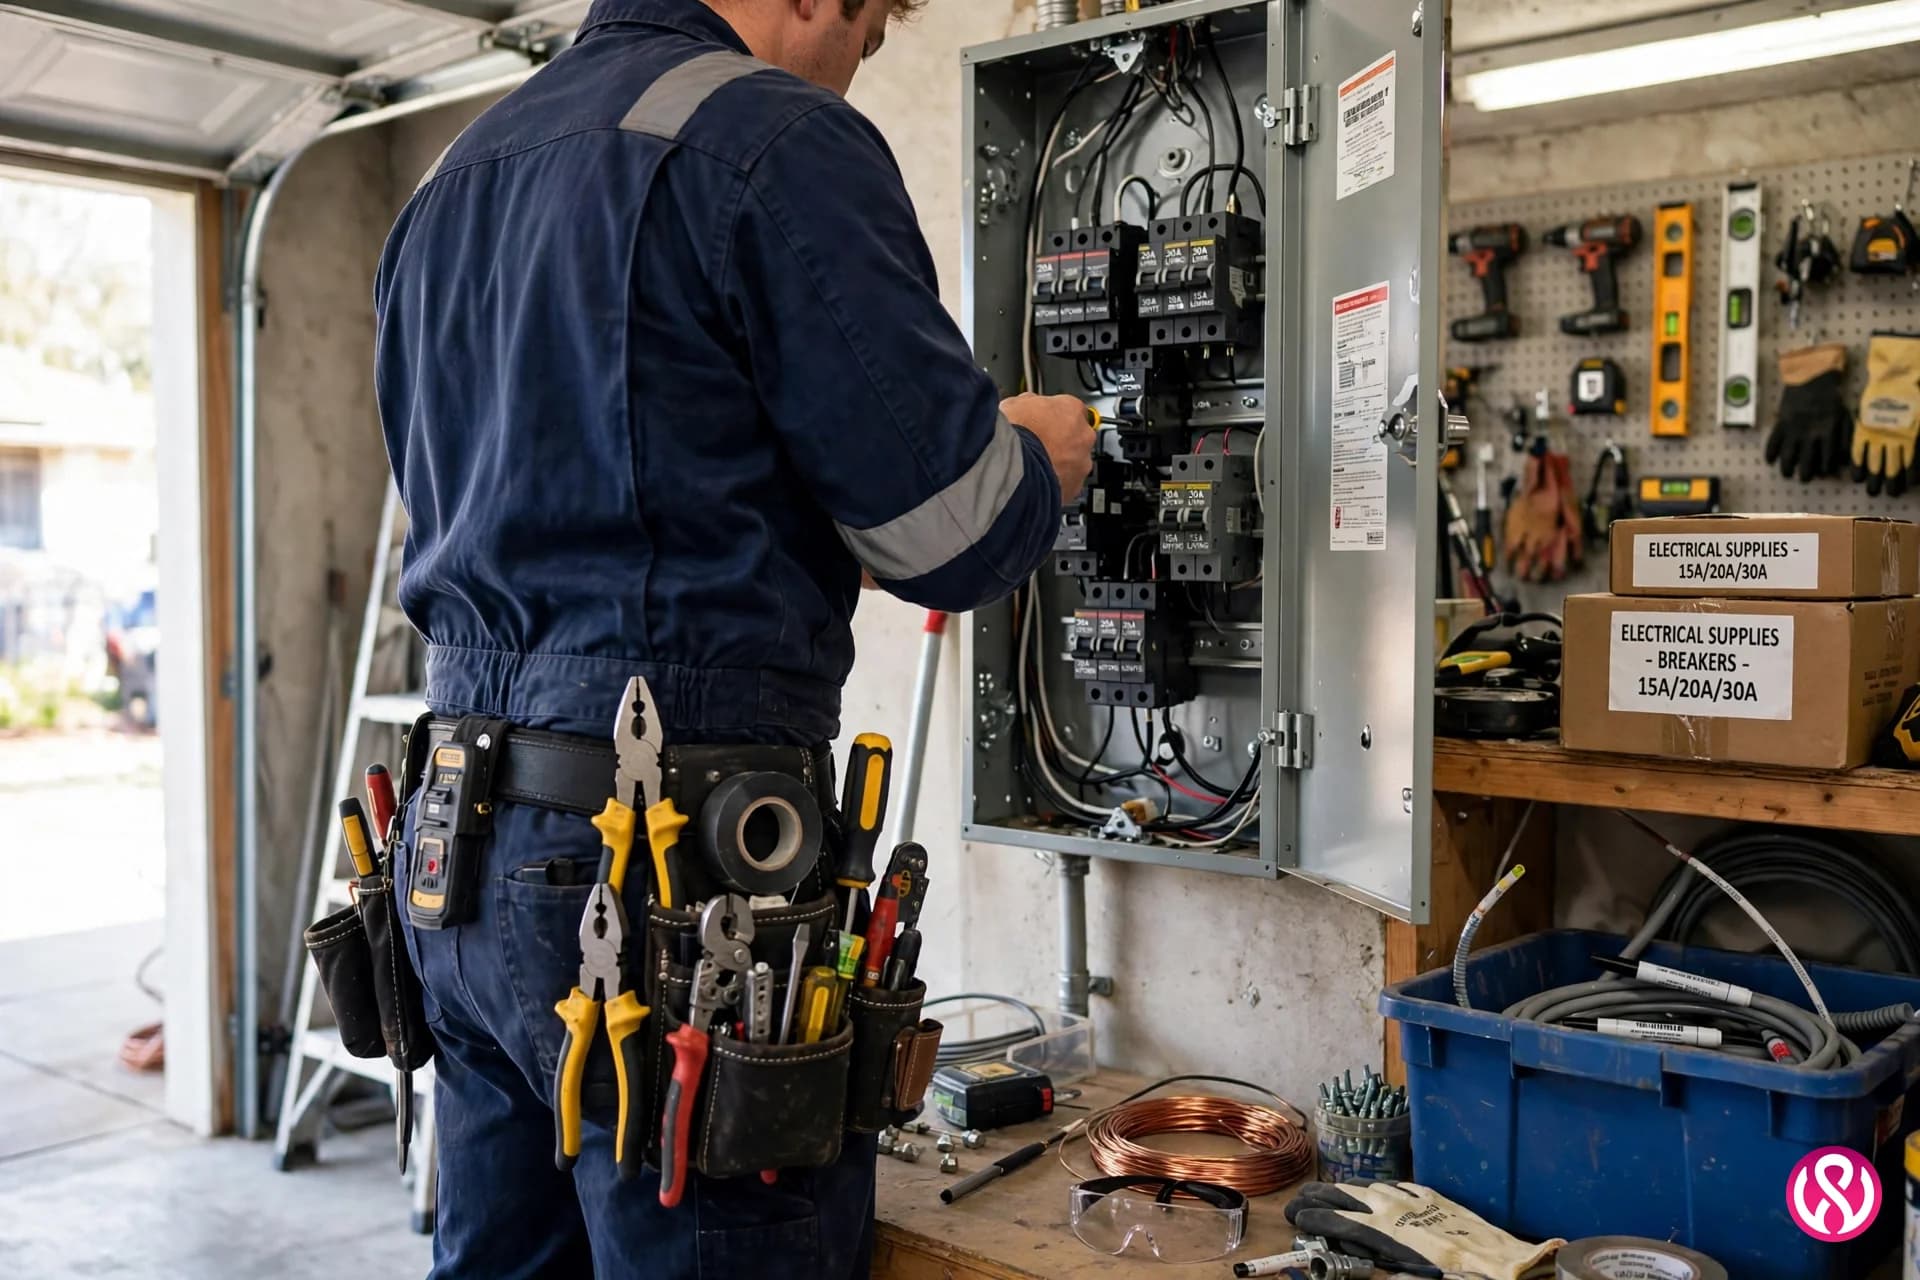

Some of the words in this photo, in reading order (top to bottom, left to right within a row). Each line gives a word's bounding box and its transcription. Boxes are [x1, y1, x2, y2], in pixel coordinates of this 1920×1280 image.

[1648, 541, 1722, 558] ELECTRICAL
[1725, 541, 1789, 558] SUPPLIES
[1678, 562, 1768, 582] 15A/20A/30A
[1621, 623, 1704, 645] ELECTRICAL
[1708, 626, 1780, 647] SUPPLIES
[1658, 651, 1737, 672] BREAKERS
[1638, 677, 1758, 702] 15A/20A/30A
